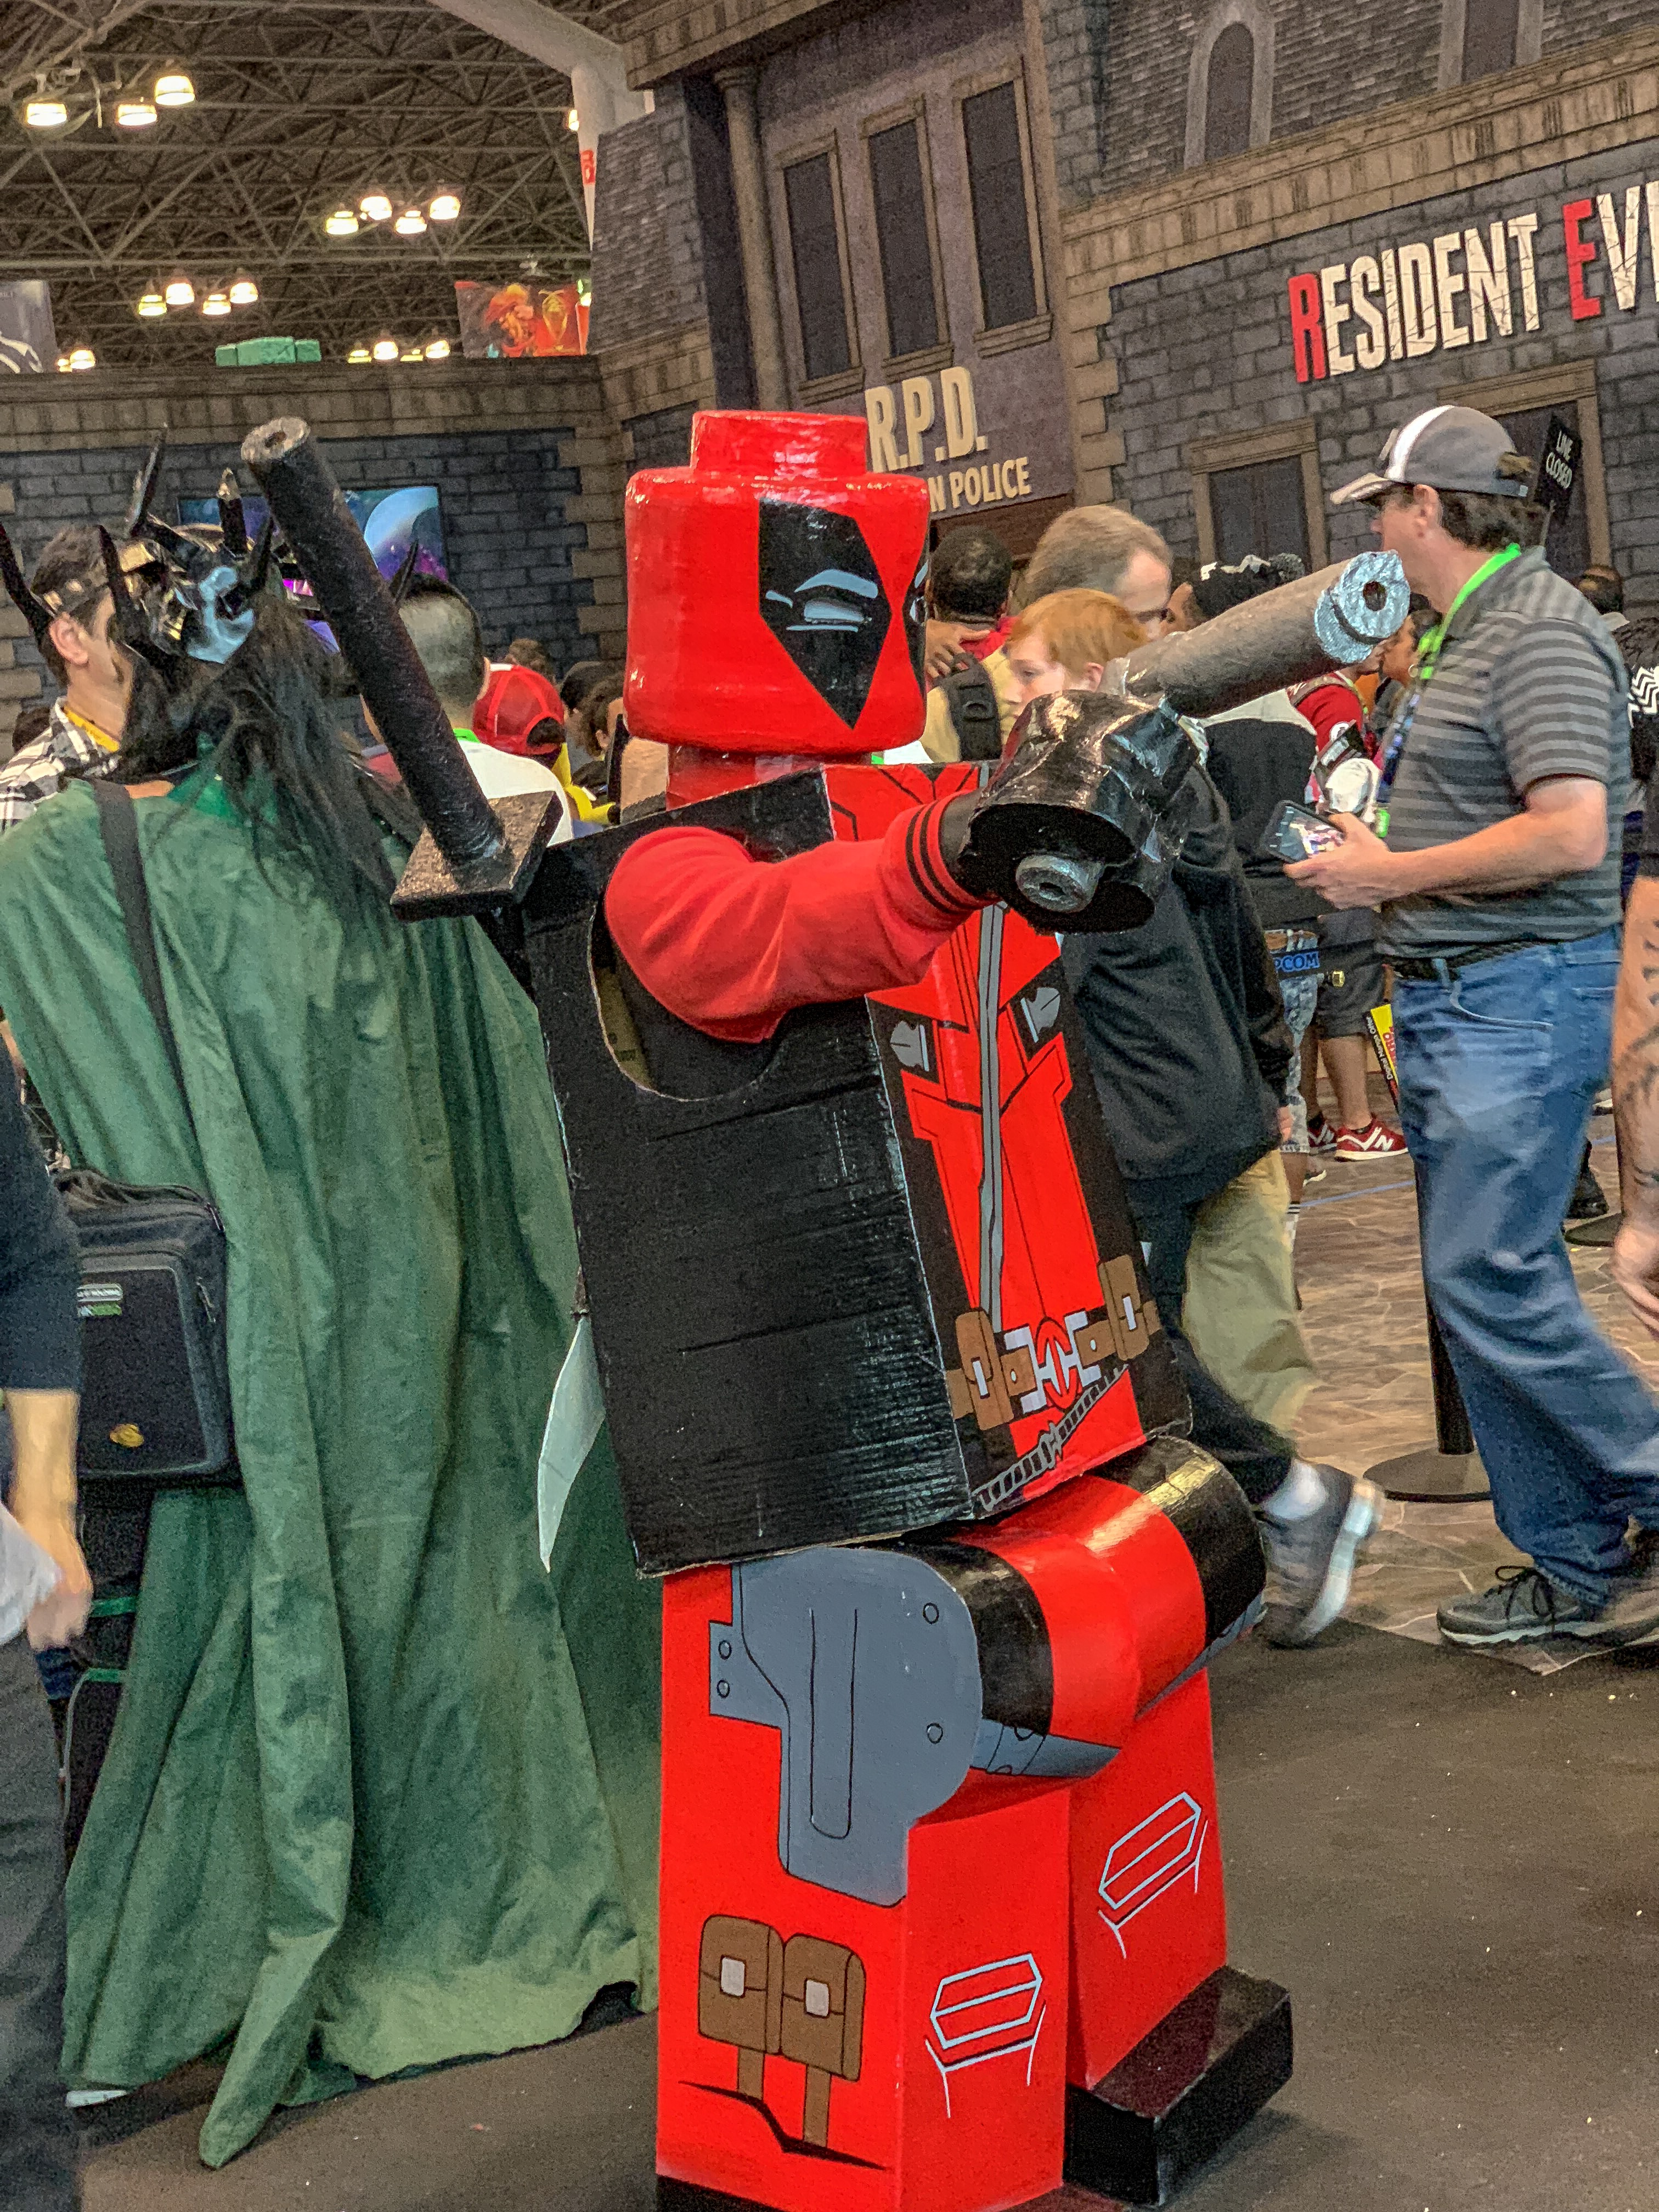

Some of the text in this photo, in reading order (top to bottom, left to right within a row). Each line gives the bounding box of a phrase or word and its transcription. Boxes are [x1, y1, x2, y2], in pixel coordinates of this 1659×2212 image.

[1288, 180, 1659, 382] RESIDENT EVI
[865, 366, 988, 472] R.P.D.
[950, 456, 1031, 508] POLICE
[1546, 452, 1572, 489] CLOSED
[1273, 951, 1321, 974] PCOM
